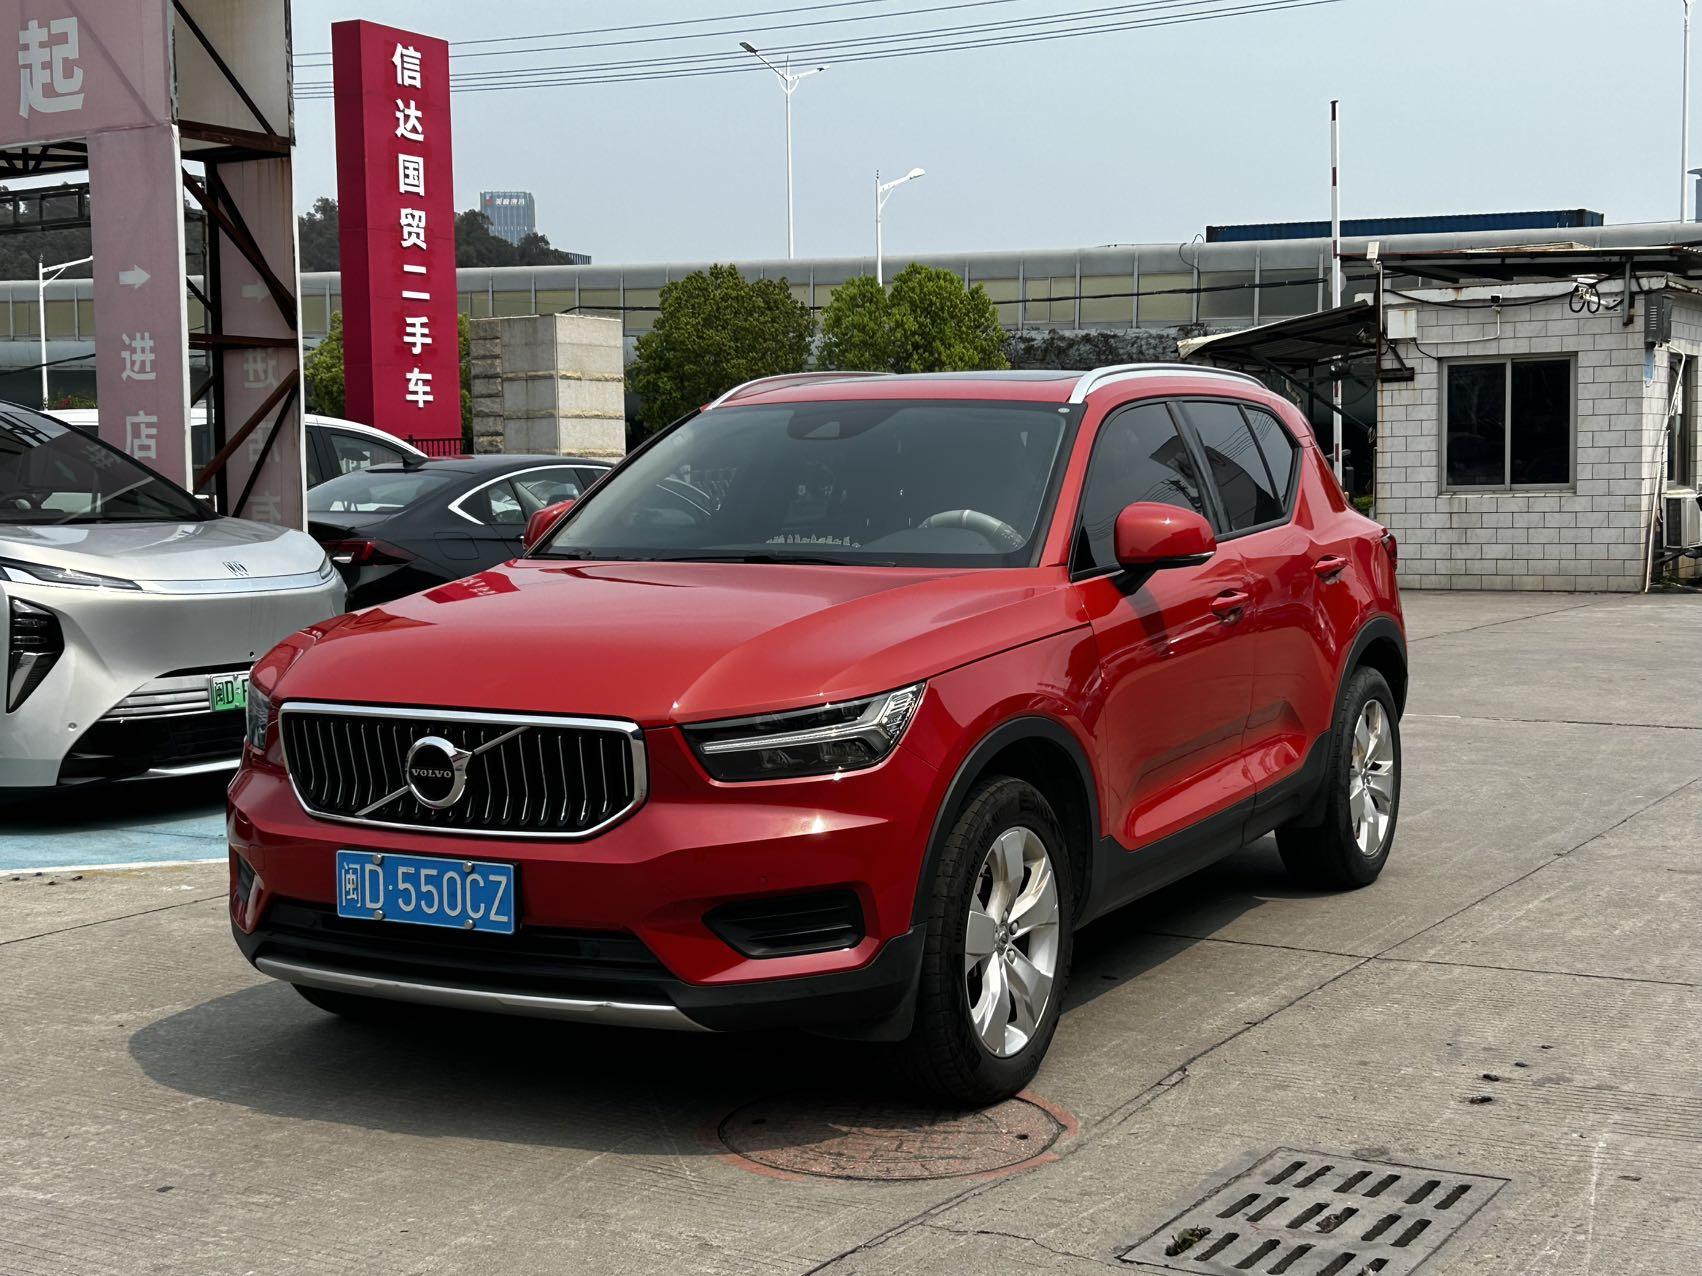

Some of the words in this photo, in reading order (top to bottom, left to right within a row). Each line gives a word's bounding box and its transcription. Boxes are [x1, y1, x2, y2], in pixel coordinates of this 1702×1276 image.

[17, 15, 85, 120] 起
[391, 42, 434, 408] 信达国贸二手车
[120, 332, 159, 461] 进店
[411, 768, 452, 779] VOLVO
